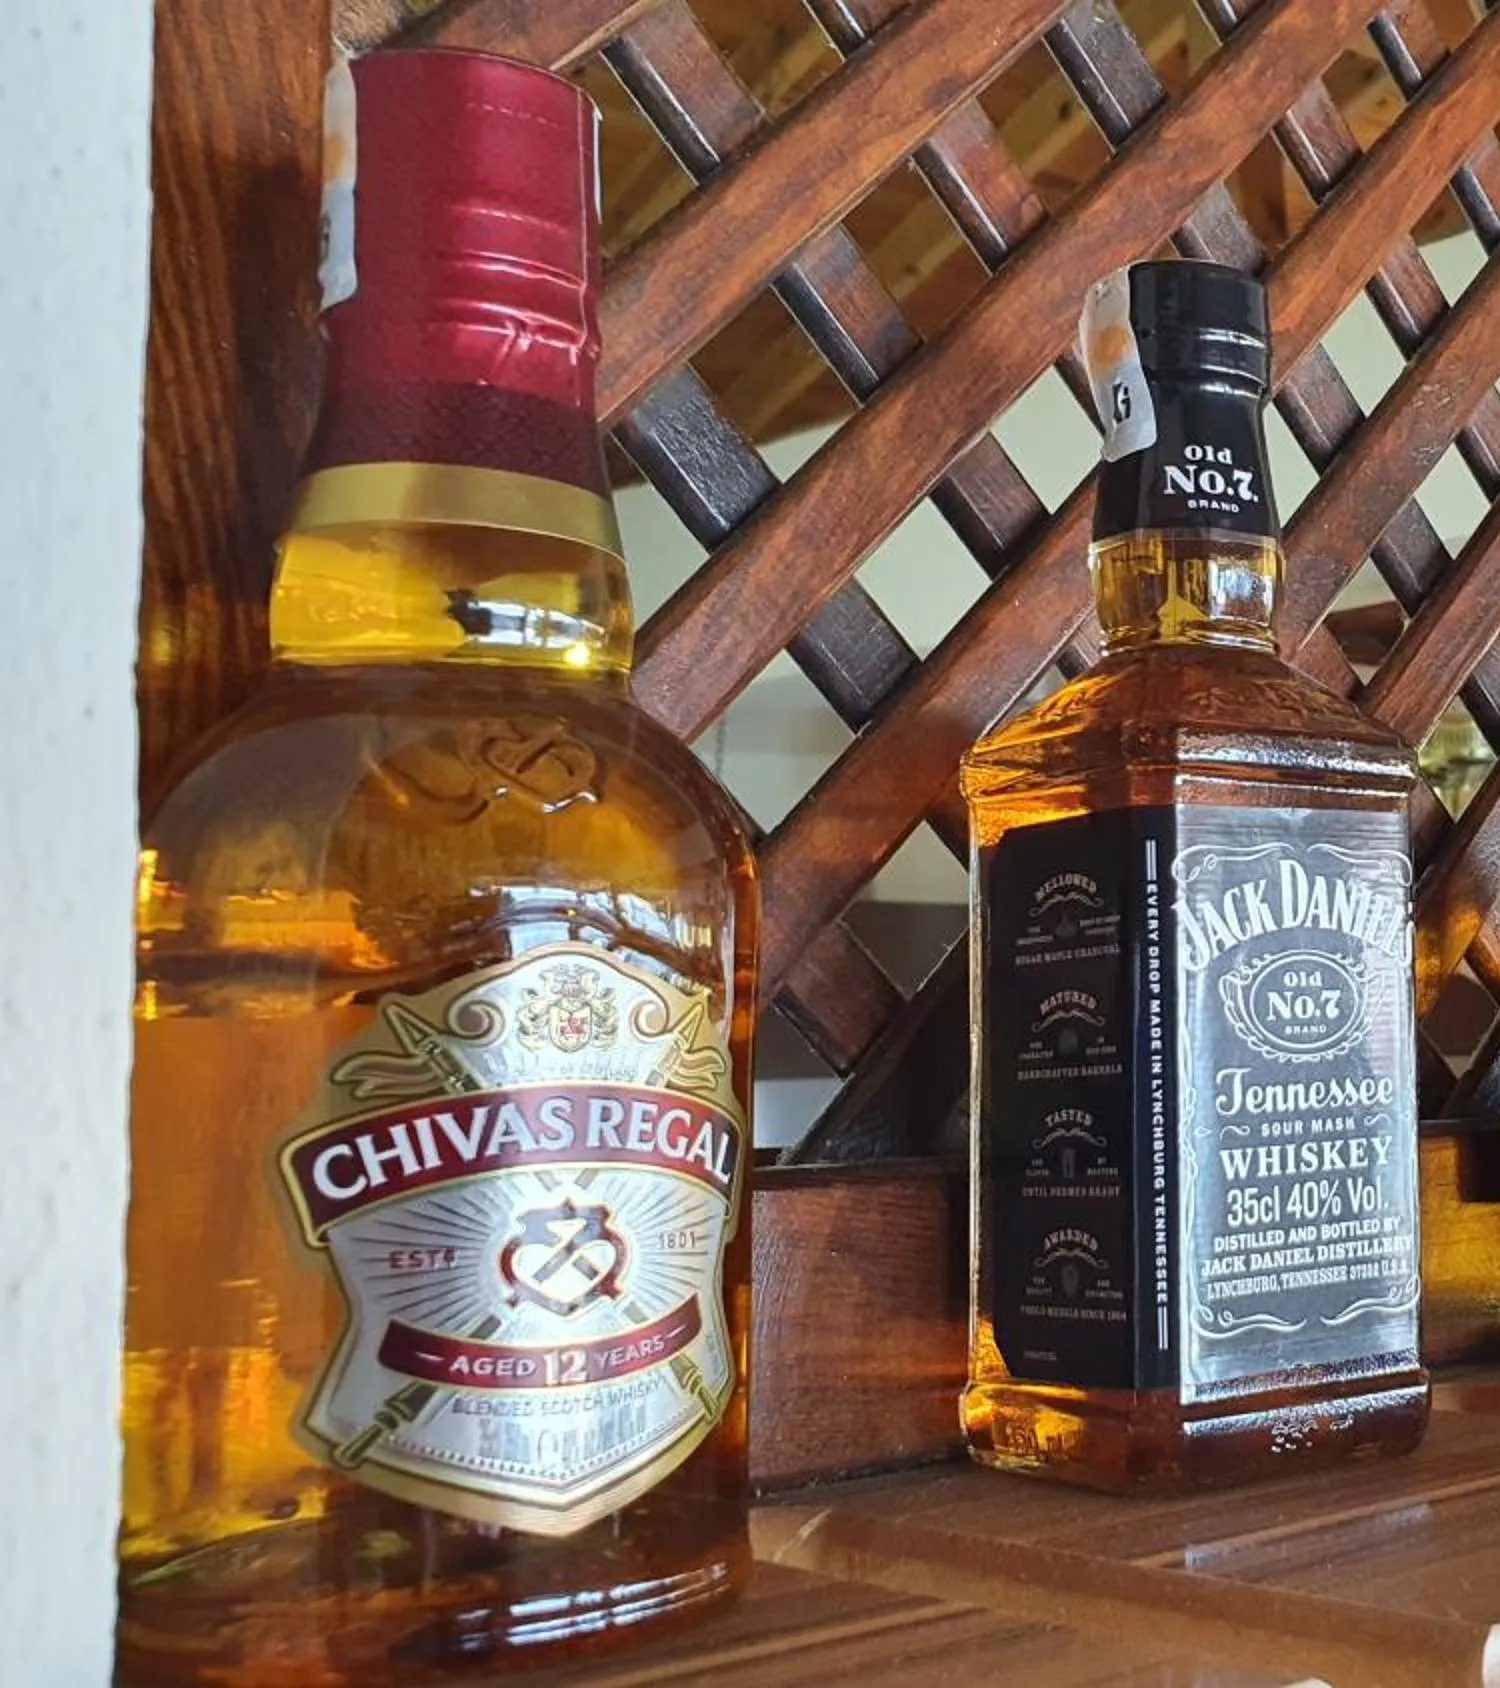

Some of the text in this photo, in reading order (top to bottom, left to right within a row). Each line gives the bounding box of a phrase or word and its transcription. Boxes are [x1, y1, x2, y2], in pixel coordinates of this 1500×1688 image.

[1183, 444, 1233, 465] Old
[1187, 499, 1240, 514] BRAND
[1035, 872, 1098, 901] MELLOWED
[1171, 879, 1278, 971] JACK
[1283, 970, 1323, 988] Old
[1039, 989, 1097, 1016] MATURED
[1266, 988, 1342, 1022] No.7
[1285, 1023, 1327, 1035] BRAND
[1146, 882, 1168, 1303] EVERY DROP MADE IN LYNCHBURG TENNESSEE
[1215, 1067, 1394, 1117] Tennessee
[1044, 1108, 1093, 1127] TASTED
[1261, 1116, 1355, 1137] SOUR MASH
[312, 1095, 733, 1201] CHIVAS REGAL
[1218, 1135, 1393, 1181] WHISKEY
[1226, 1175, 1389, 1227] 35cl 40% Vol.
[658, 1230, 697, 1251] 1801
[1044, 1227, 1099, 1252] AWARDED
[1213, 1216, 1401, 1253] DISTILLED AND BOTTLED BY
[1201, 1236, 1412, 1278] JACK DANIEL DISTILLERY
[1281, 1265, 1348, 1292] TENNESSEE
[449, 1333, 665, 1387] AGED 12 YEARS
[452, 1373, 664, 1418] BLENDED SCOTCH WHISKY
